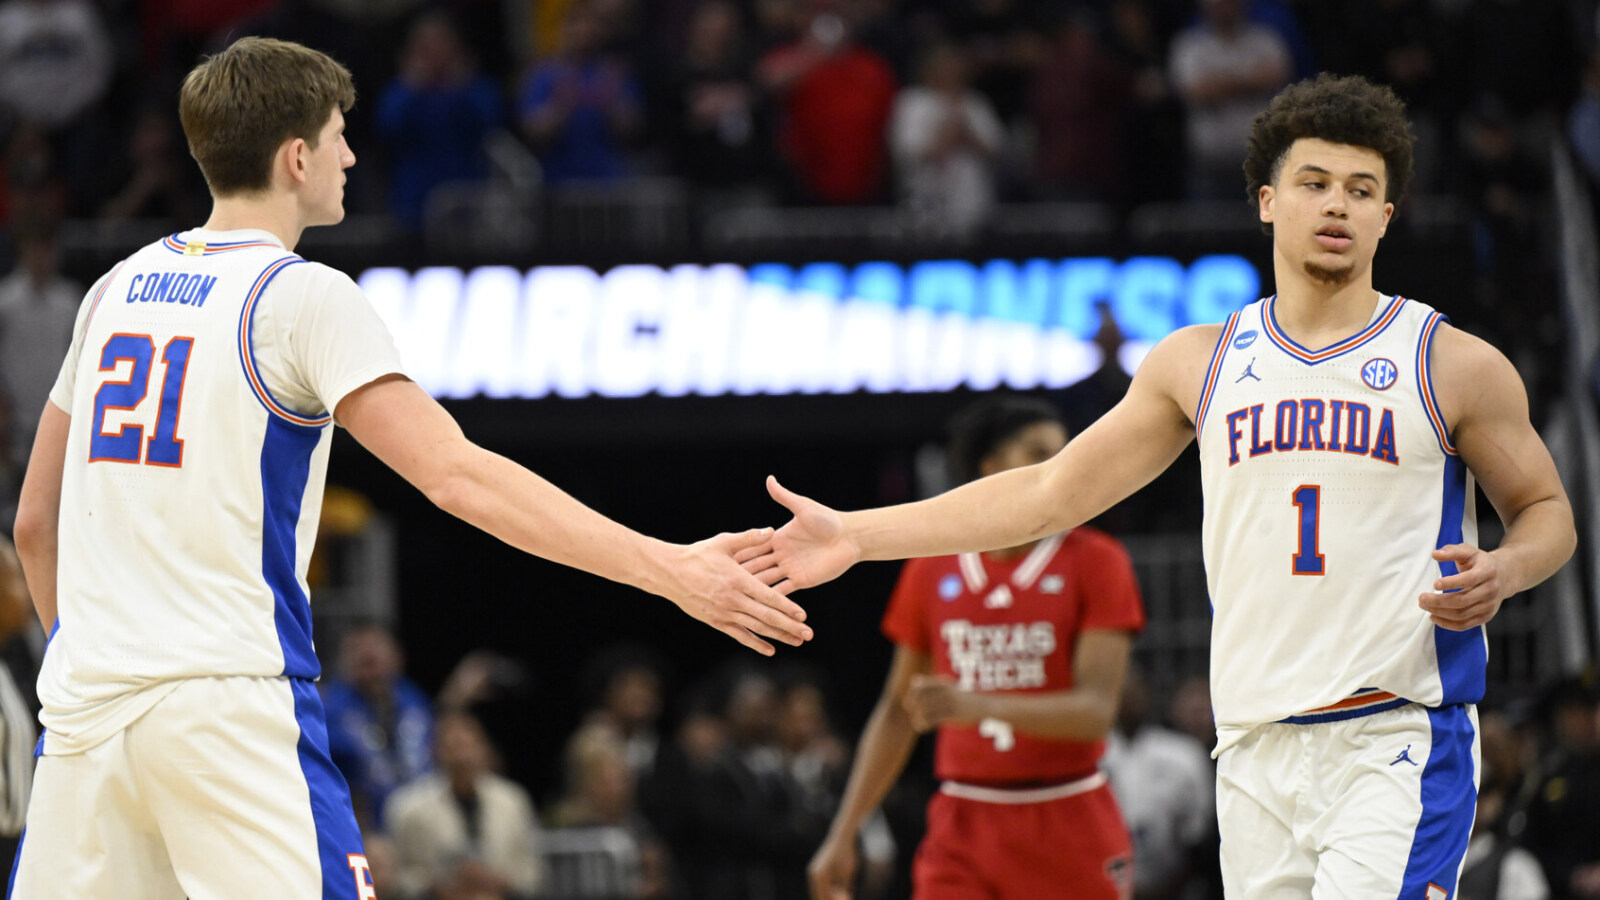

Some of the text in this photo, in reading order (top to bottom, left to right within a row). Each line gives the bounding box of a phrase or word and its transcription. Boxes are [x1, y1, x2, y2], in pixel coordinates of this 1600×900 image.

[126, 272, 217, 307] CONDON
[357, 265, 754, 399] MARCH
[88, 332, 194, 467] 21
[1364, 359, 1395, 388] SEC
[1226, 398, 1400, 467] FLORIDA
[1292, 484, 1326, 576] 1
[940, 618, 1056, 656] TEXAS
[950, 654, 1047, 692] TECH
